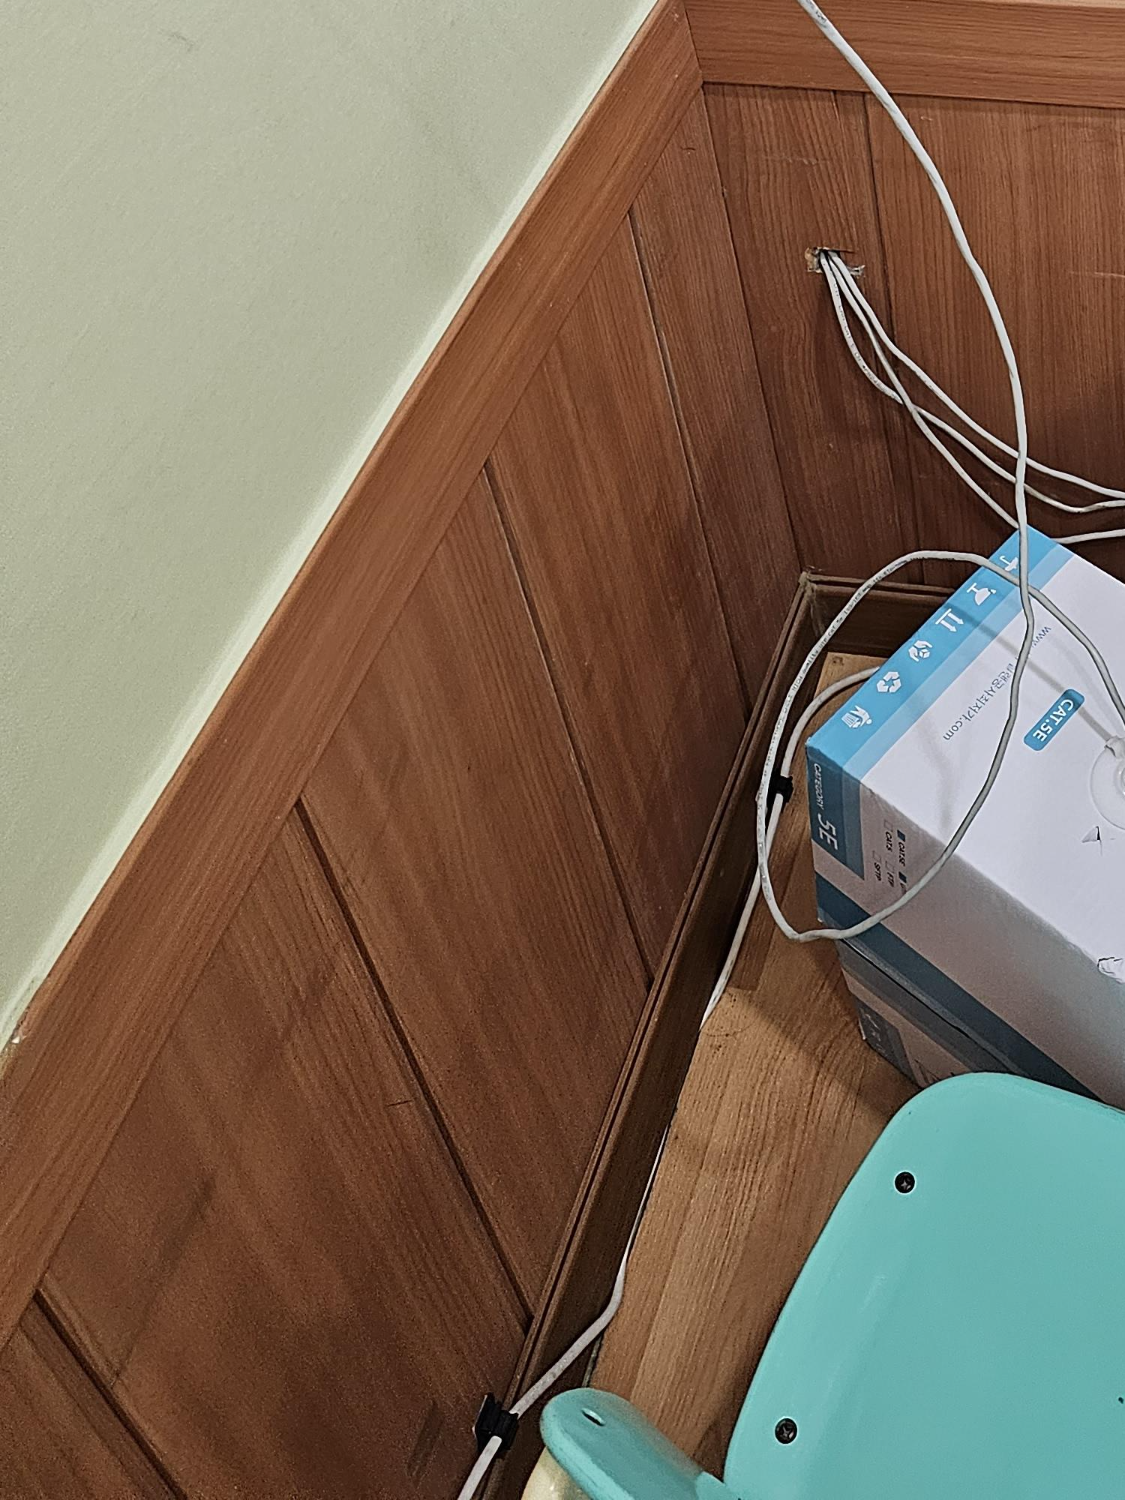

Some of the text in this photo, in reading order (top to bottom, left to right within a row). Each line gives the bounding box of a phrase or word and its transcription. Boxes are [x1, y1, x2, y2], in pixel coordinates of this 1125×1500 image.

[1033, 698, 1075, 743] CAT.5E
[814, 763, 838, 850] CATEGORY 5E
